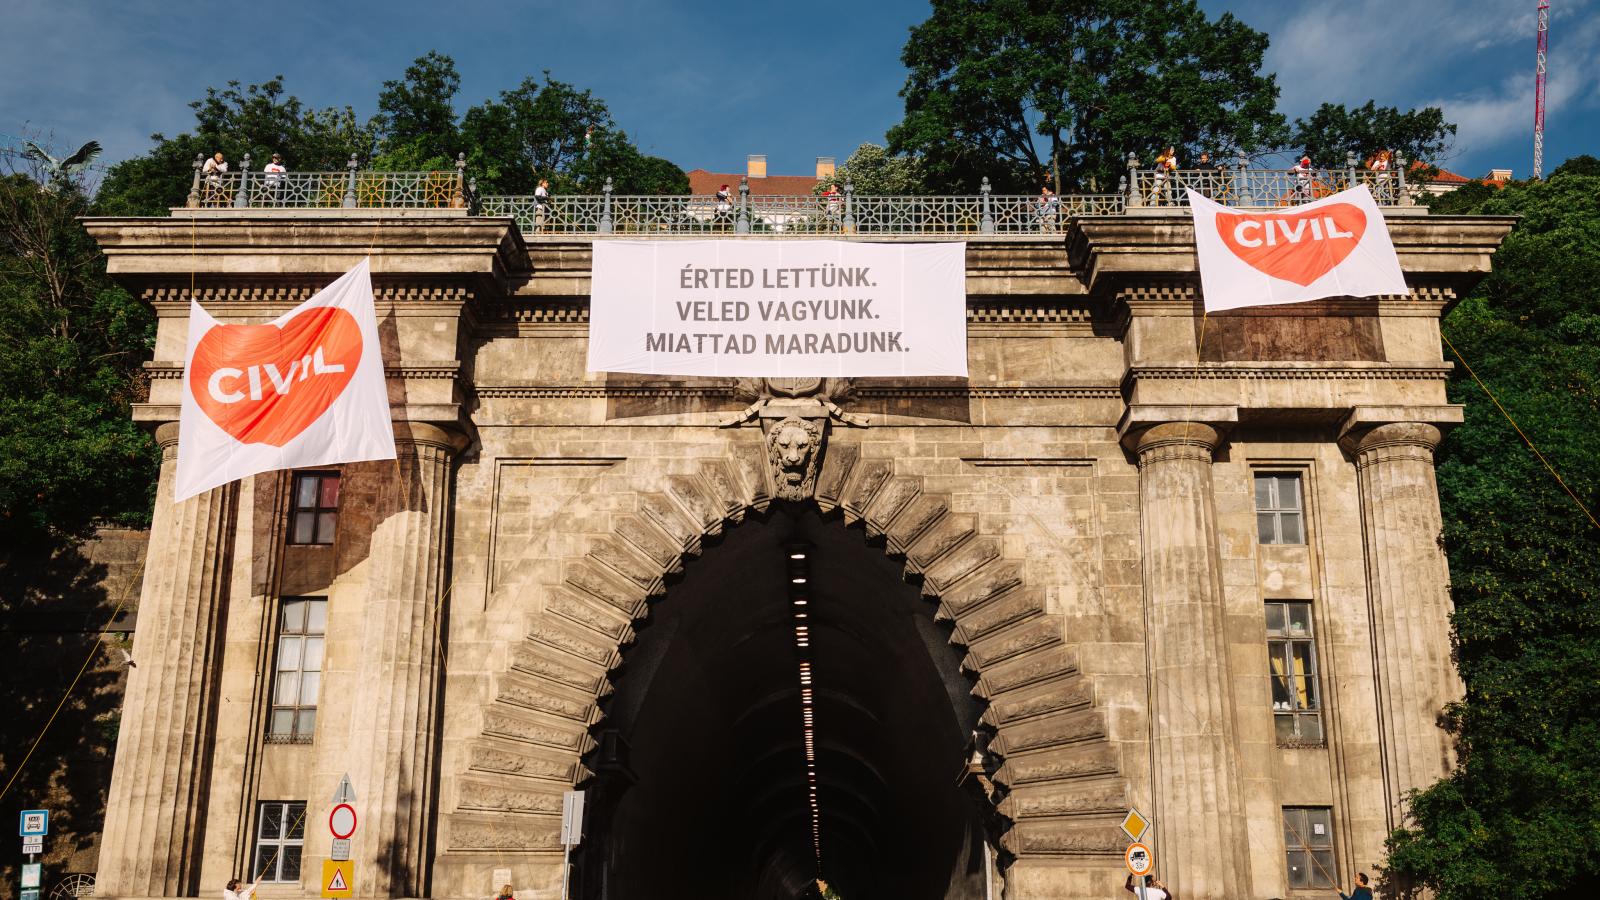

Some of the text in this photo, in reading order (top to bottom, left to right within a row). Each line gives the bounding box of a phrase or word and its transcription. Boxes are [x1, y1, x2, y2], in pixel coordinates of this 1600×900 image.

[1234, 216, 1353, 248] CIVIL
[680, 263, 877, 289] ÉRTED LETTÜNK.
[676, 299, 880, 322] VELED VAGYUNK.
[646, 332, 910, 355] MIATTAD MARADUNK.
[207, 345, 345, 404] CIVIL
